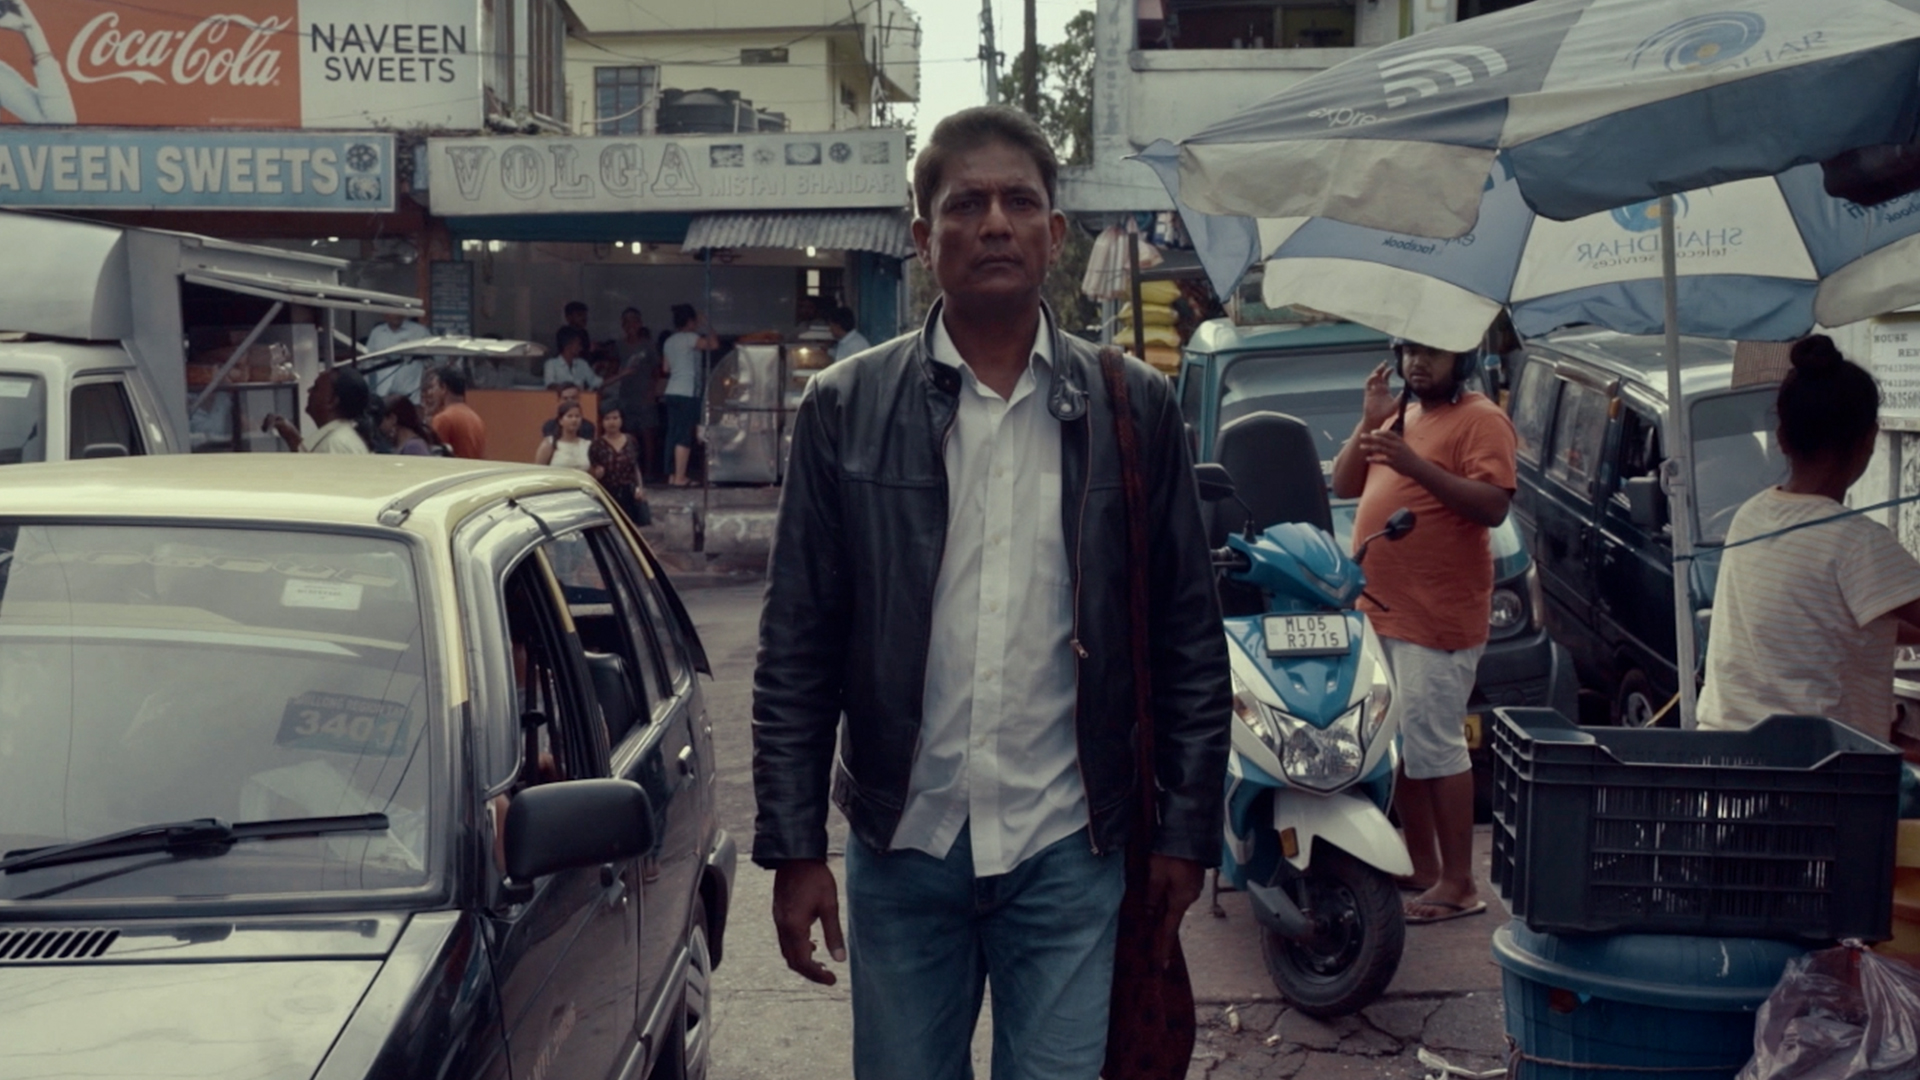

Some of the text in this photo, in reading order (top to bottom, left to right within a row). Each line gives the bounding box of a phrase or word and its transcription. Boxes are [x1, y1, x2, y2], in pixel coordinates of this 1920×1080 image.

[66, 12, 293, 86] Coca-Cola
[310, 23, 467, 55] NAVEEN
[324, 57, 456, 83] SWEETS
[156, 146, 339, 194] SWEETS
[444, 143, 702, 201] VOLGA
[796, 171, 897, 195] BHANDAR
[1873, 333, 1908, 343] HOUSE
[1898, 348, 1920, 357] REN
[1285, 616, 1327, 632] ML05
[1287, 632, 1339, 648] R3715
[295, 709, 402, 750] 3401
